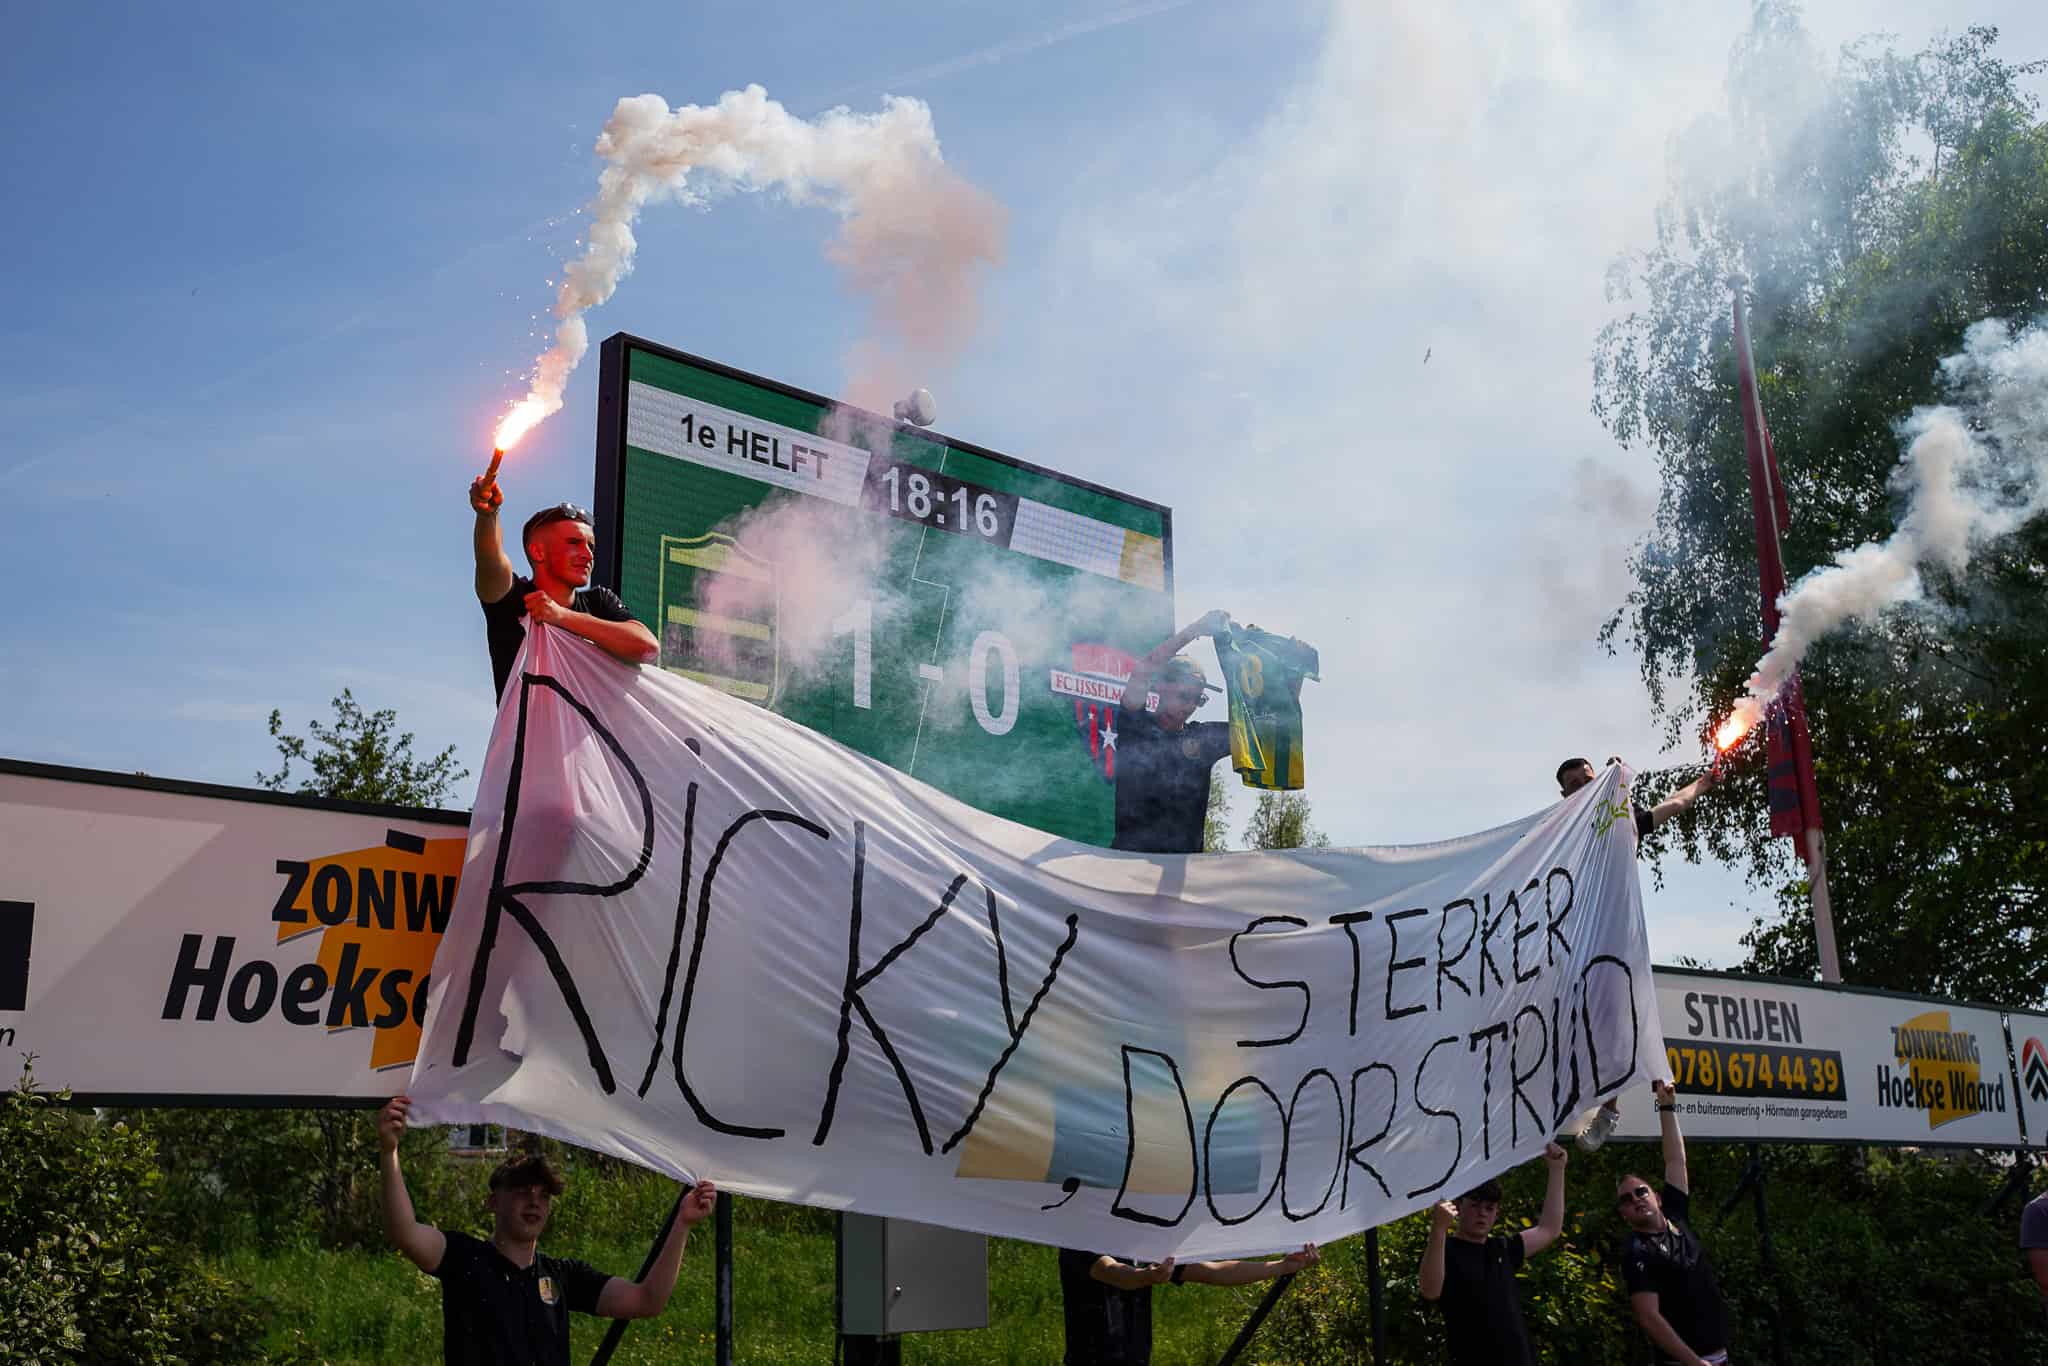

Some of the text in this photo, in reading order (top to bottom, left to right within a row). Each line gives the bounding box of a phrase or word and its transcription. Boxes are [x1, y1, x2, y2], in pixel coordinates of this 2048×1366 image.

[681, 414, 829, 481] 1e HELFT
[882, 466, 999, 538] 18:16
[832, 597, 872, 709] 1
[968, 629, 1021, 736] 0
[1055, 675, 1073, 691] FC
[1229, 867, 1575, 1048] STERKER
[1684, 991, 1803, 1044] STRIJEN
[1891, 1026, 1981, 1064] ZONWERING
[1728, 1052, 1774, 1089] 674
[1778, 1055, 1807, 1091] 44
[1810, 1056, 1840, 1093] 39
[1877, 1064, 2006, 1113] Hoekse Waard
[1686, 1104, 1696, 1114] en
[1697, 1101, 1760, 1120] buitenzonwering
